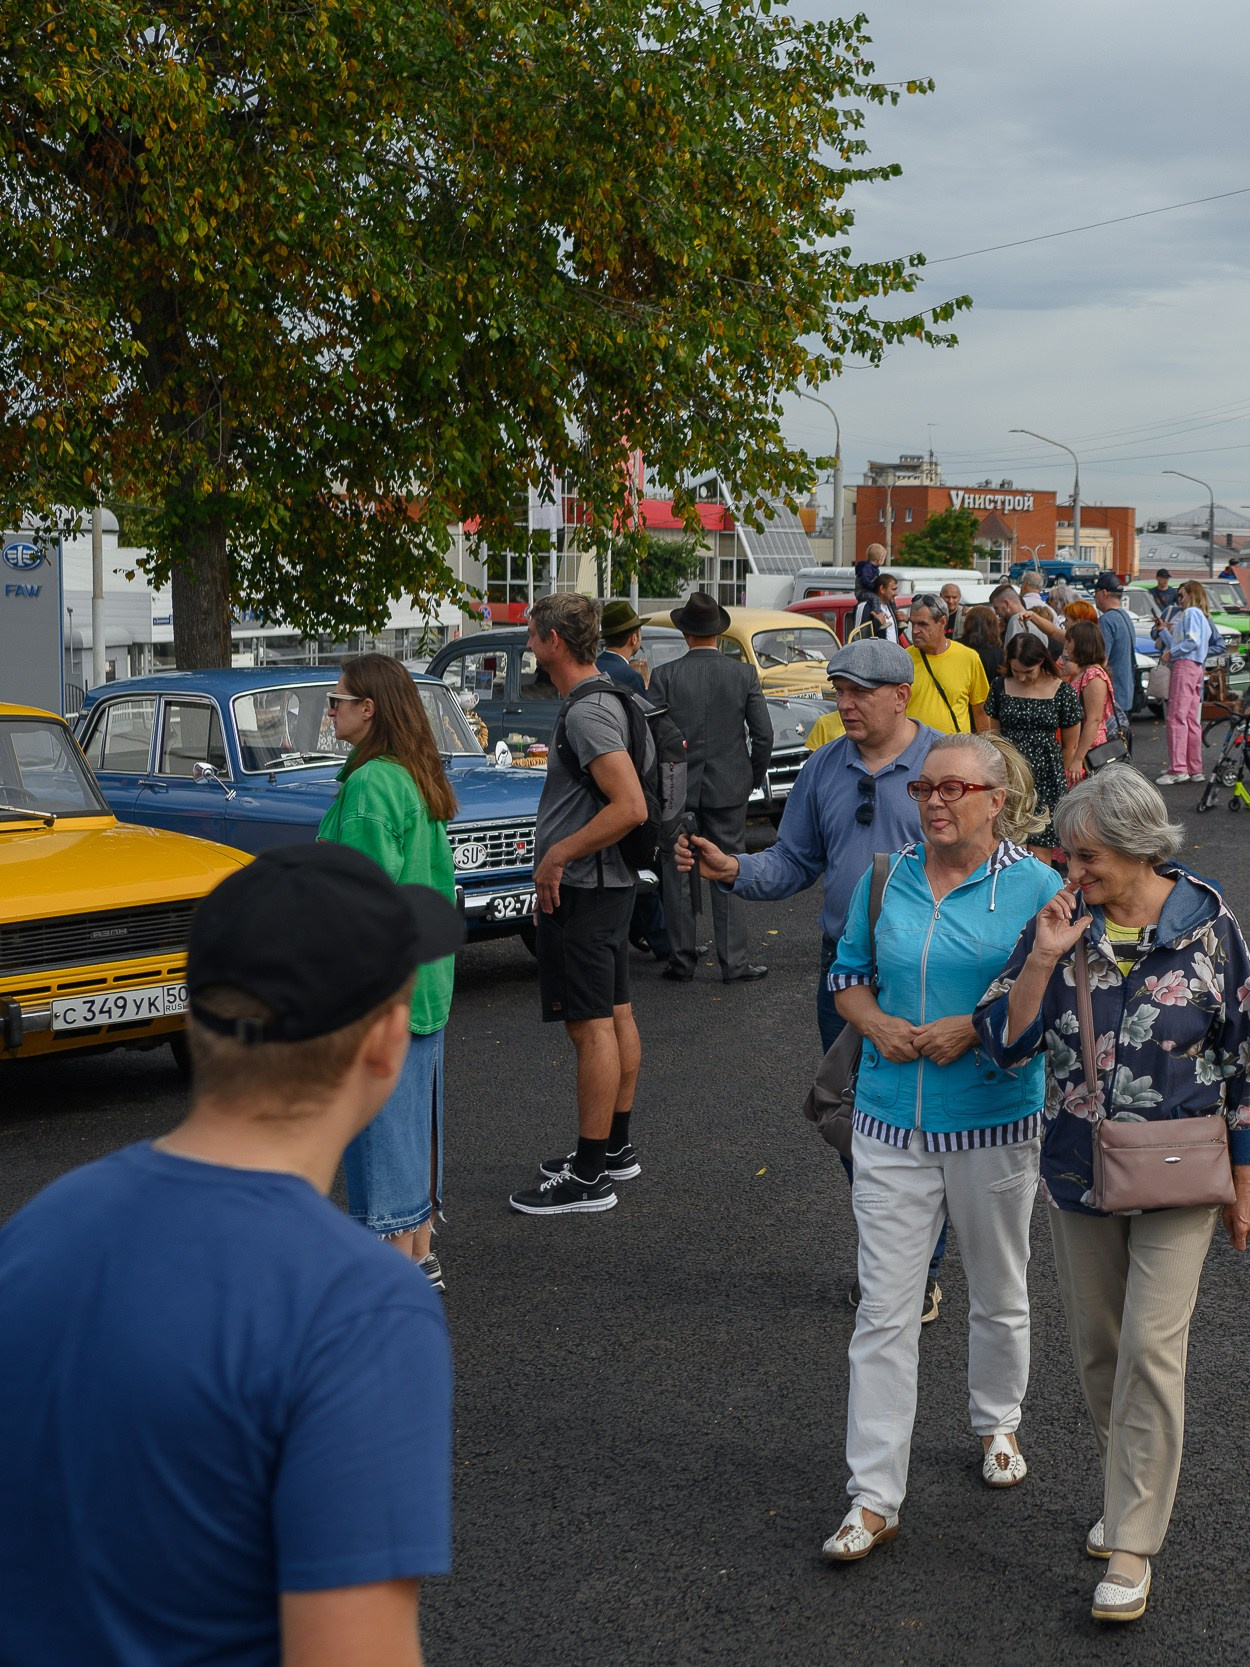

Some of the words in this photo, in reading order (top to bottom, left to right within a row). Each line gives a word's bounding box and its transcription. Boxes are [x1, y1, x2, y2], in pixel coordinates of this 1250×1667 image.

[949, 489, 1035, 514] Унистрой
[5, 583, 42, 598] FAW
[462, 846, 479, 865] SU
[166, 985, 189, 1004] 50
[165, 1003, 183, 1012] RUS
